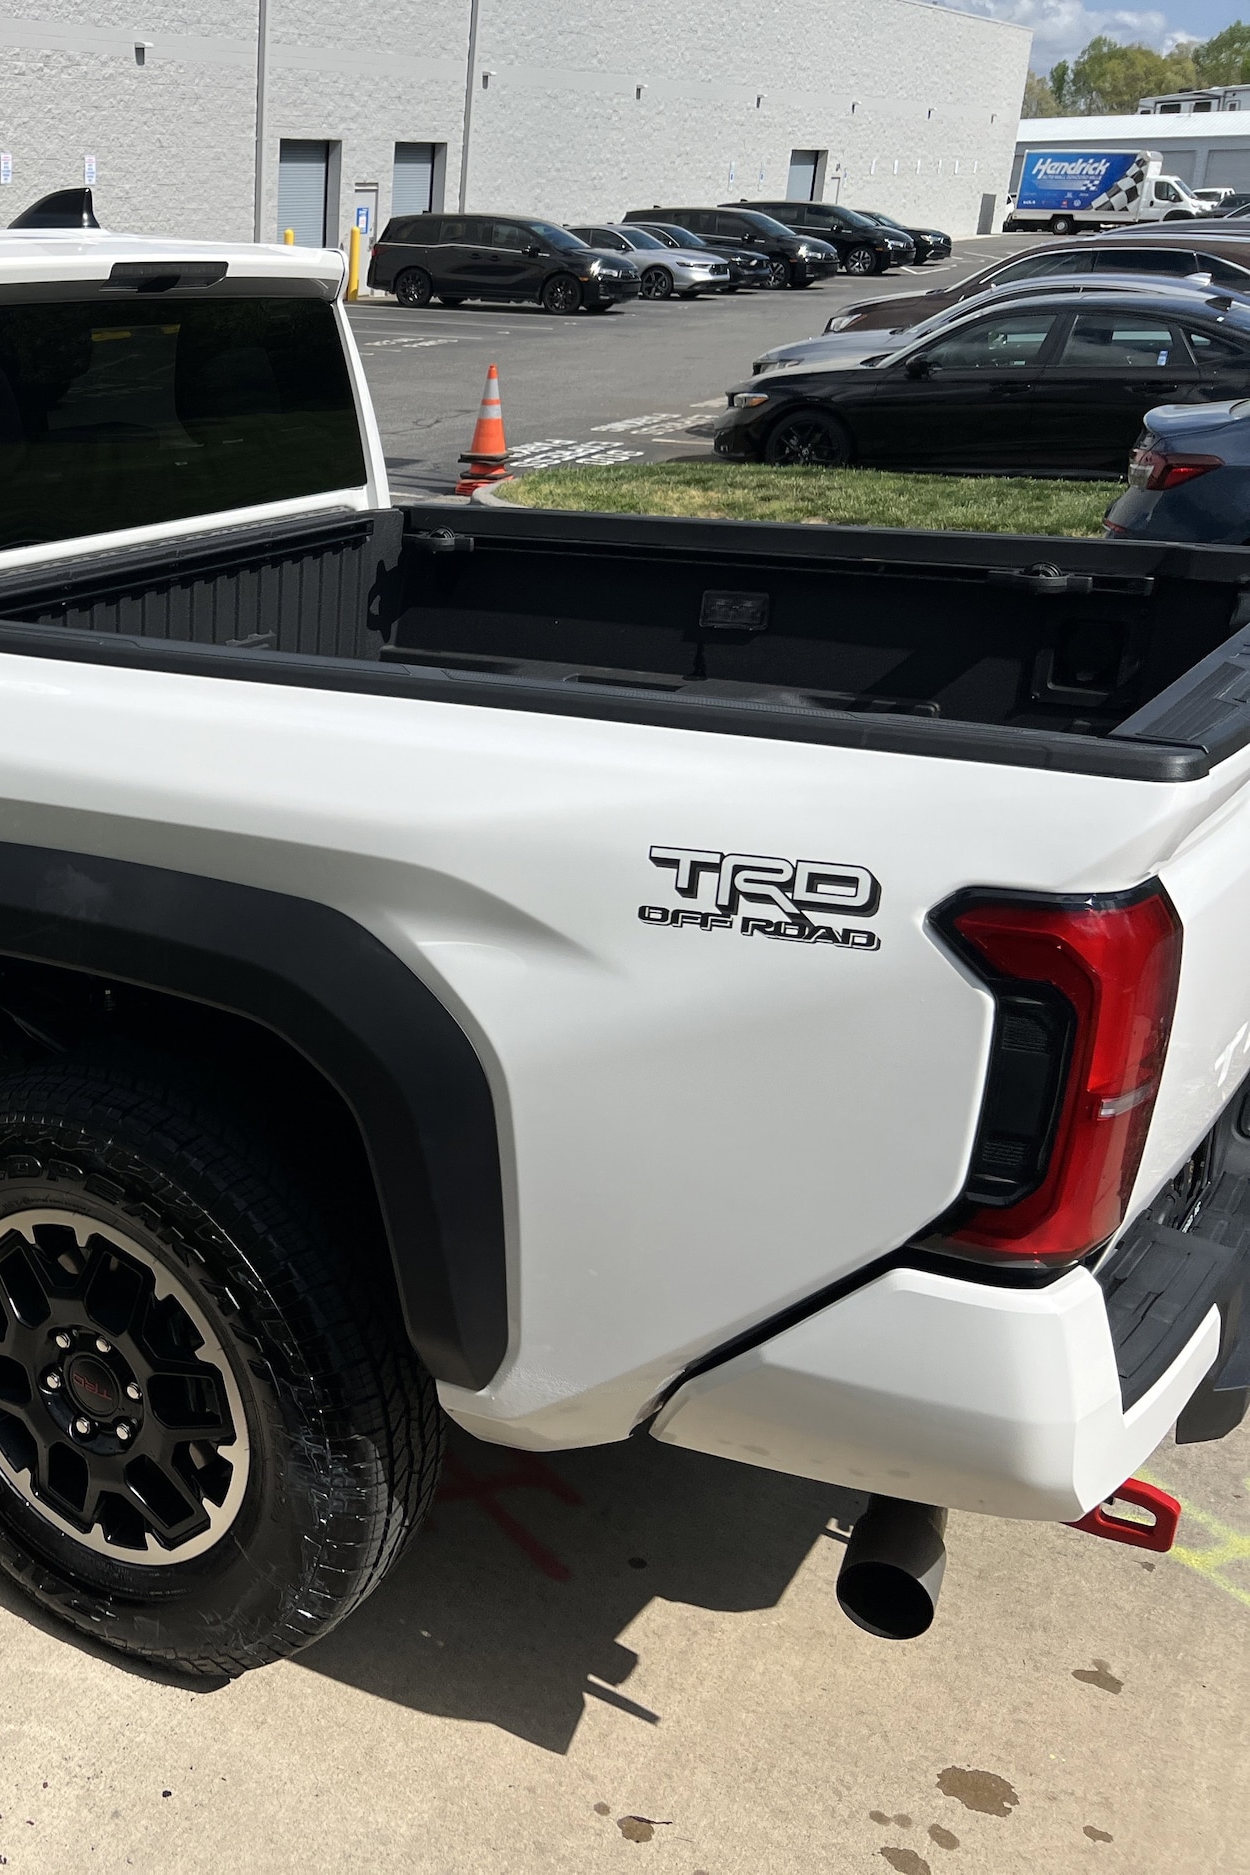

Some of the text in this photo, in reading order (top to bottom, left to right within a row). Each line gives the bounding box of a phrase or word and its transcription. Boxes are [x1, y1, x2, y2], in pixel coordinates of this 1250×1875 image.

[1032, 158, 1110, 179] Hendrick
[648, 845, 882, 918] TRD
[637, 905, 882, 951] OFF ROAD
[73, 1371, 113, 1400] TRD
